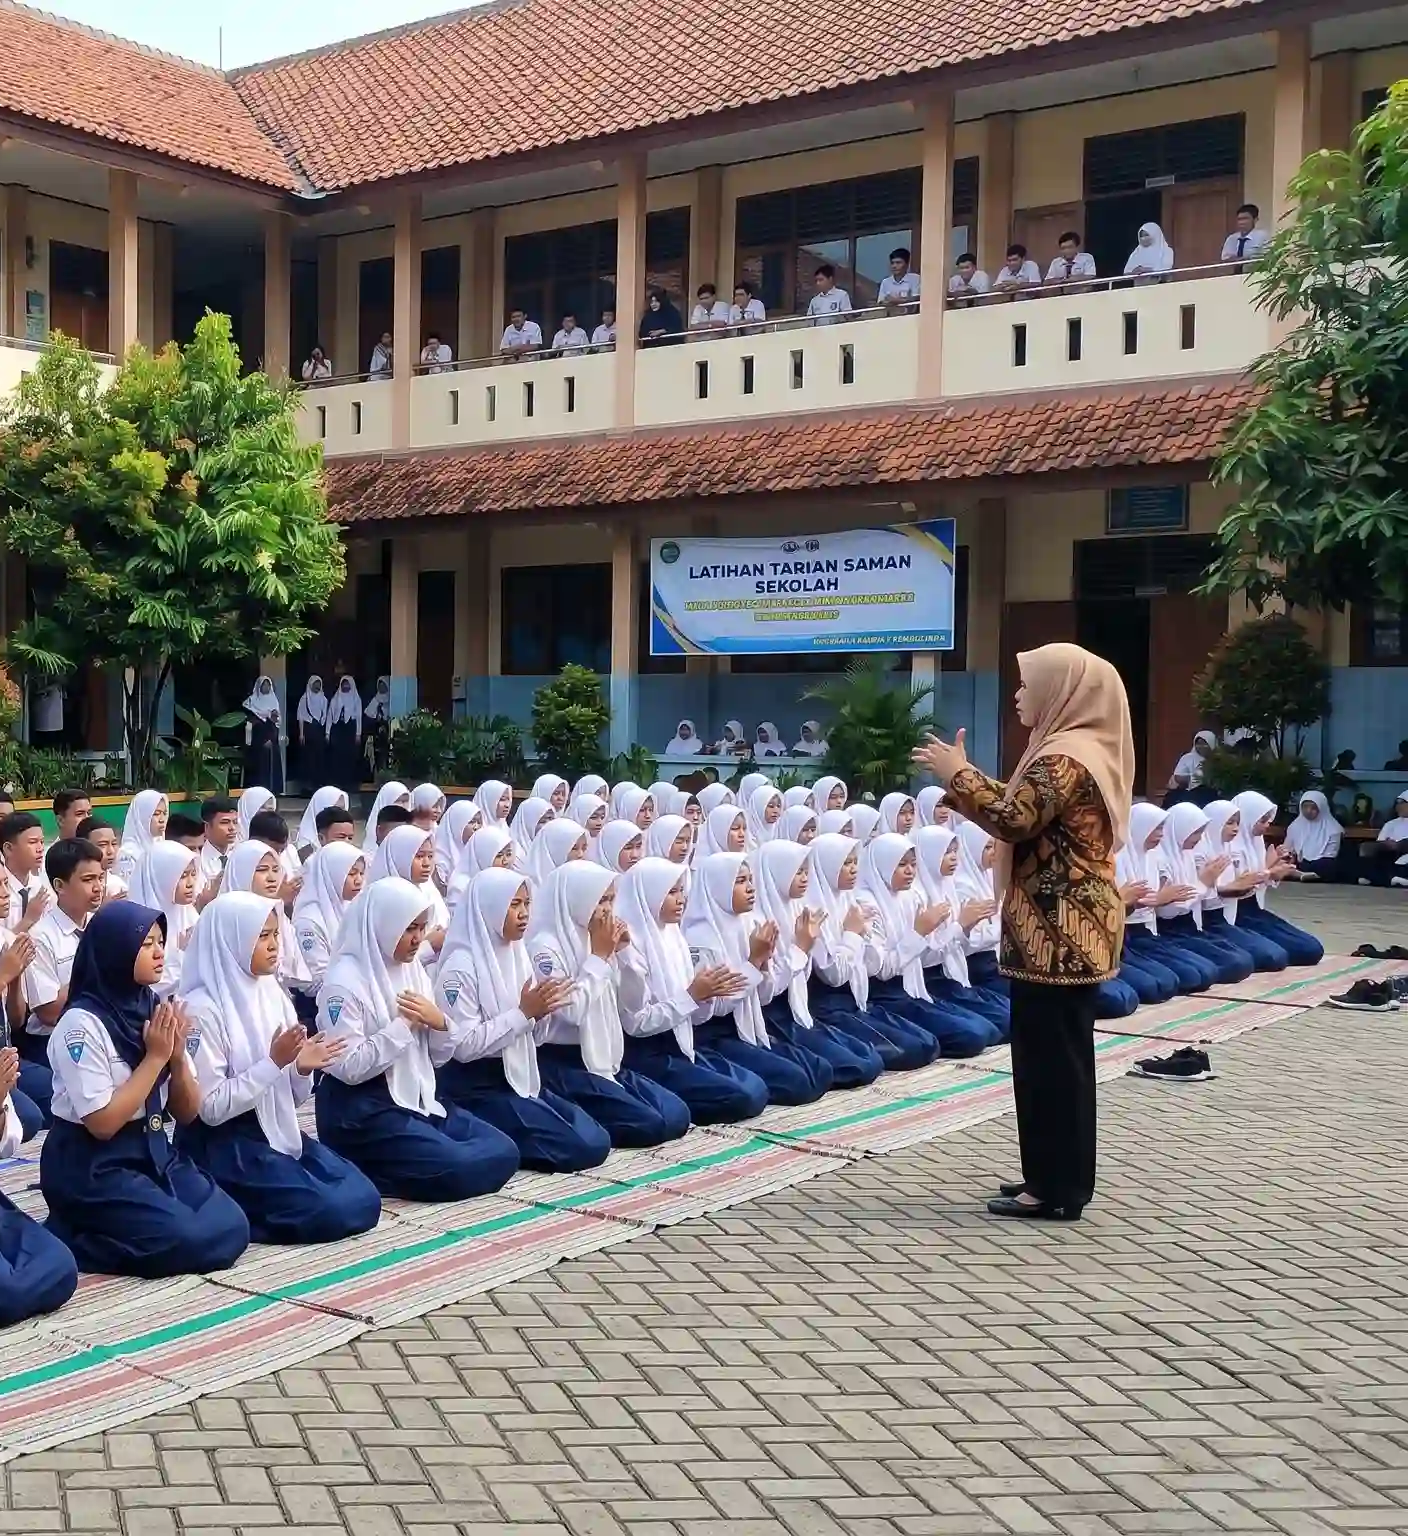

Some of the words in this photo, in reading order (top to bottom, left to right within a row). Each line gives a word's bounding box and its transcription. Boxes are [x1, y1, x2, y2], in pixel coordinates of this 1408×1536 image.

[689, 563, 765, 580] LATIHAN
[768, 560, 838, 576] TARIAN
[843, 554, 911, 571] SAMAN
[755, 577, 839, 594] SEKOLAH
